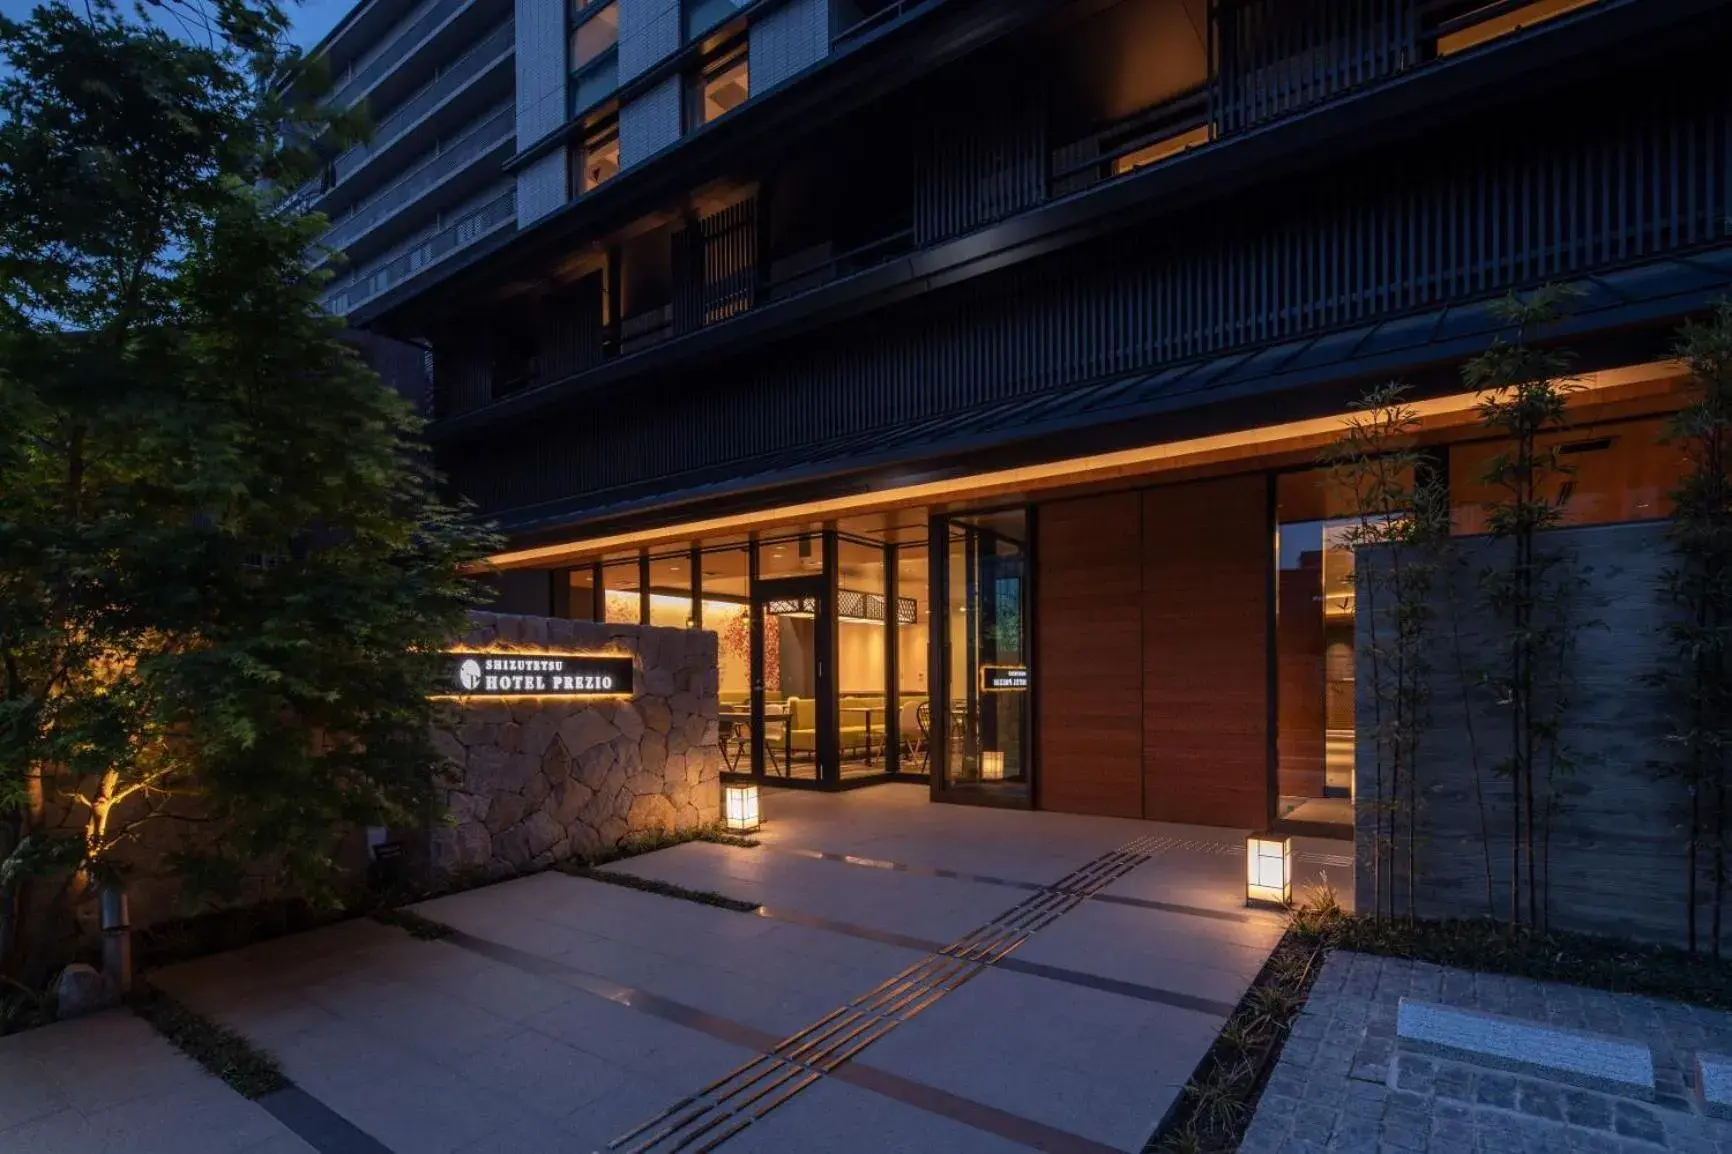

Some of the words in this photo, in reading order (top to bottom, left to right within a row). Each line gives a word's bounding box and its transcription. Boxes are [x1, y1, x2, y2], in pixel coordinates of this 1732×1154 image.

[485, 659, 563, 671] SHIZUTETSU
[485, 676, 545, 690] HOTEL
[553, 676, 613, 690] PREZIO
